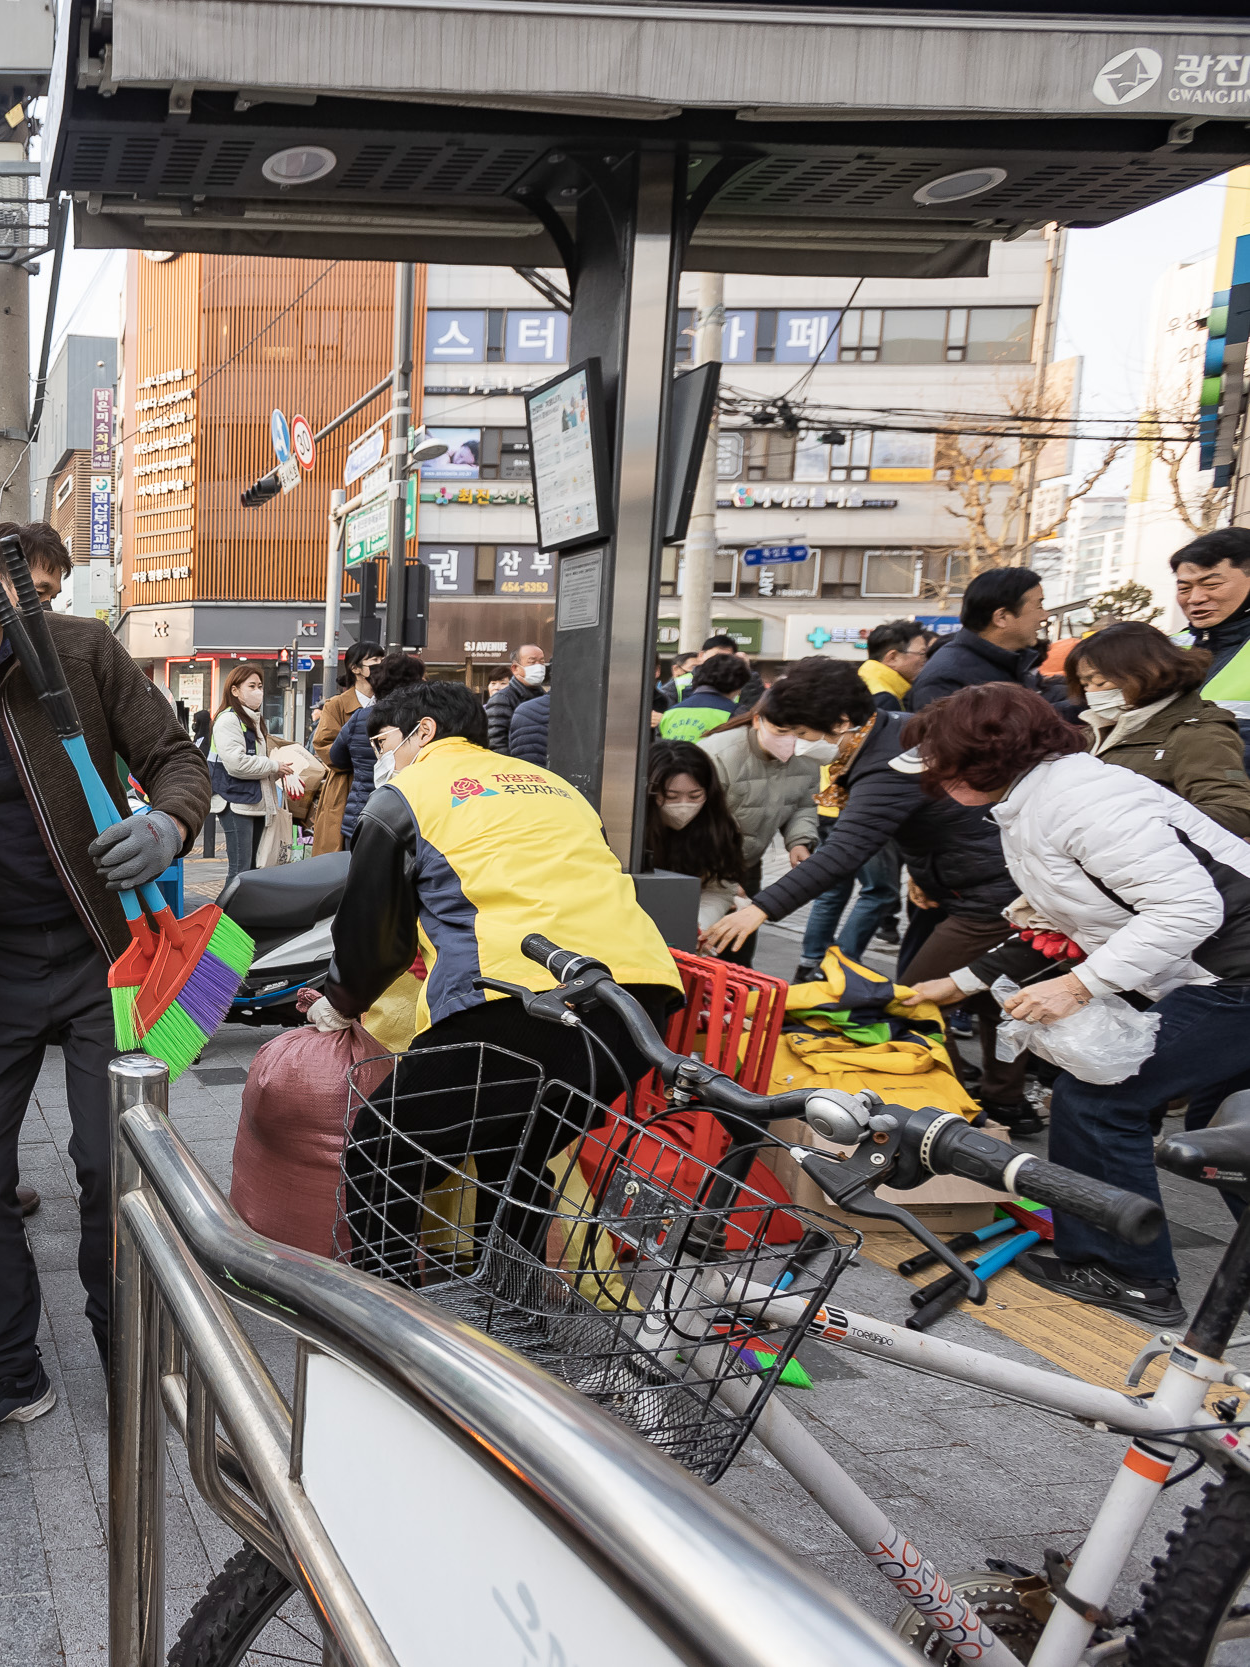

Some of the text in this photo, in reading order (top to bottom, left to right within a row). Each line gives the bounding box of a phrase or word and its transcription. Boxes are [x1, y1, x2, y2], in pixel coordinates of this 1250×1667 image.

[297, 430, 310, 456] 30
[428, 549, 459, 590] 권
[152, 620, 170, 639] kt
[297, 618, 318, 637] kt
[476, 641, 508, 653] AVENUE
[491, 773, 547, 784] 자양3동
